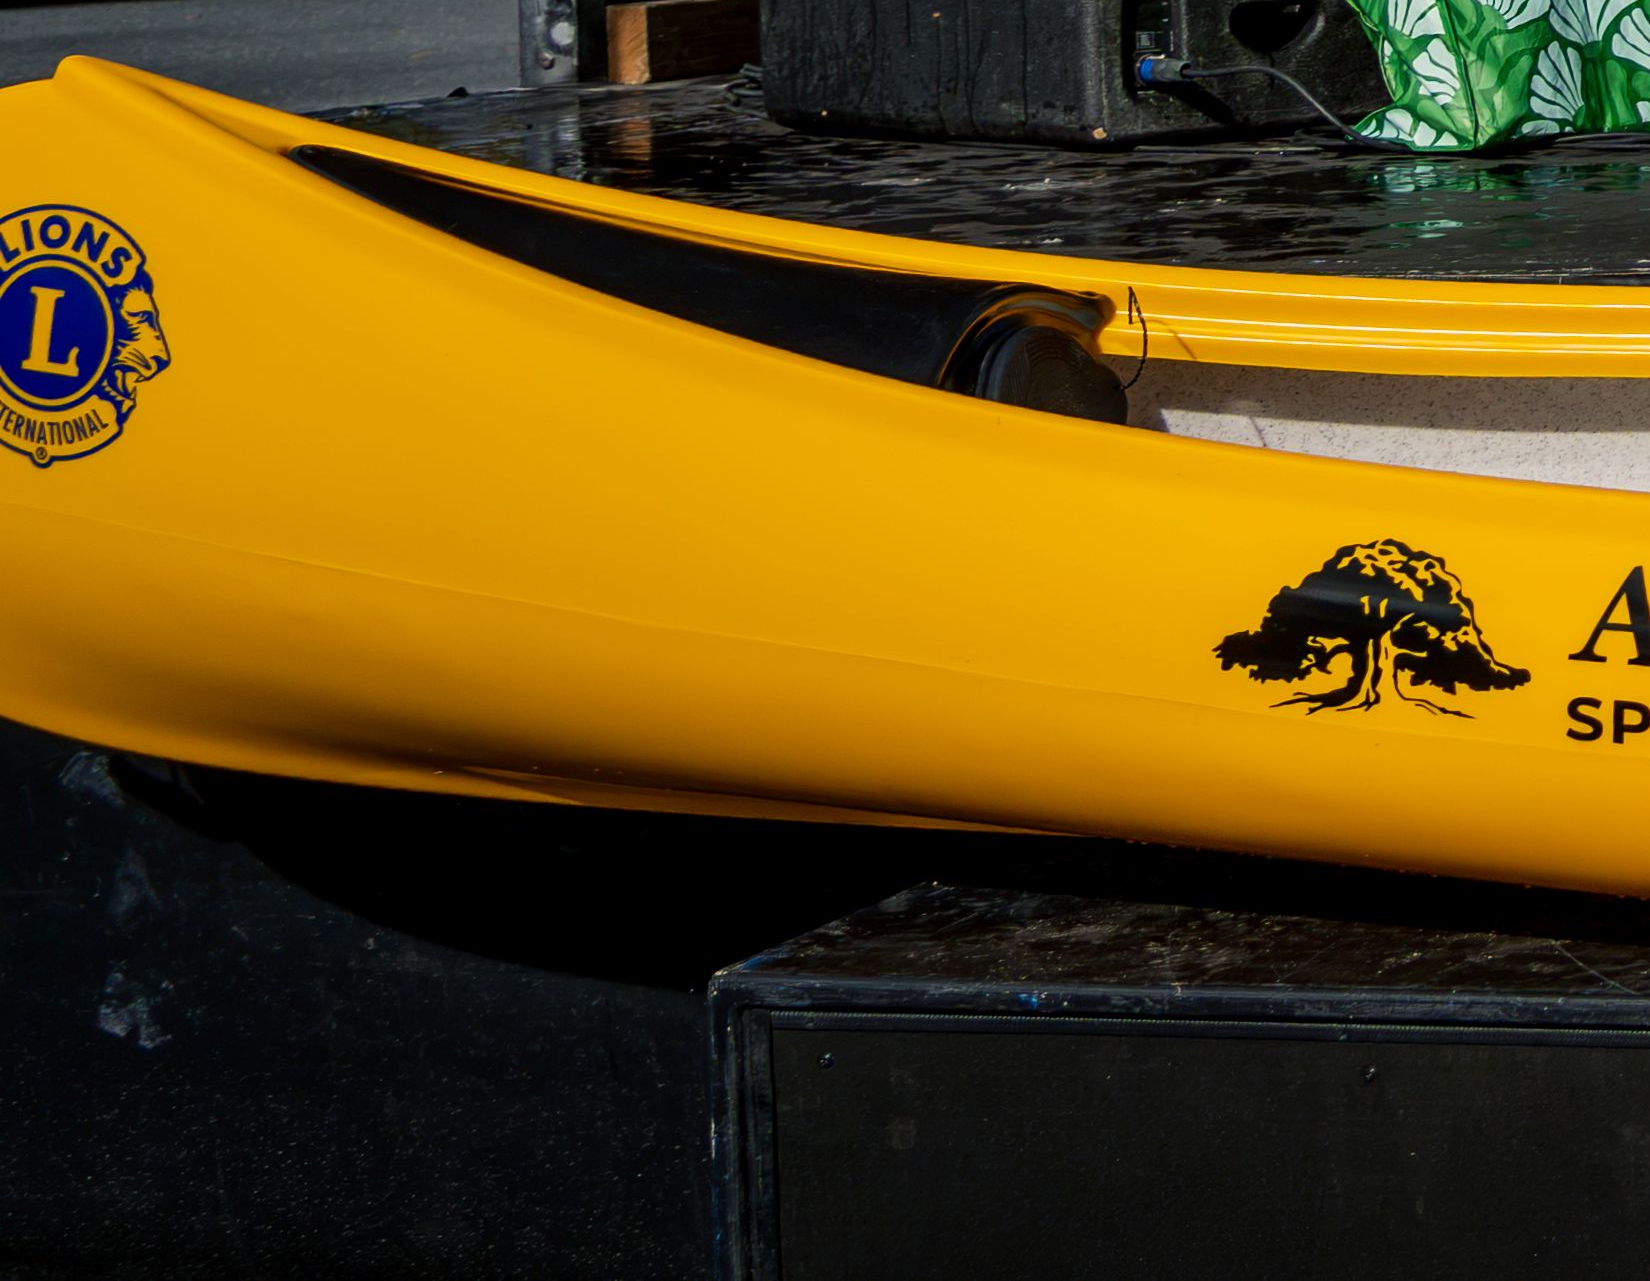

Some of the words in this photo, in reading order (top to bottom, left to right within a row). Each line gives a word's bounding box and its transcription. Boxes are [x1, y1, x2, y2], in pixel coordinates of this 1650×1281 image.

[0, 215, 132, 278] LIONS
[21, 286, 79, 377] L
[0, 400, 108, 446] TERNATIONAL
